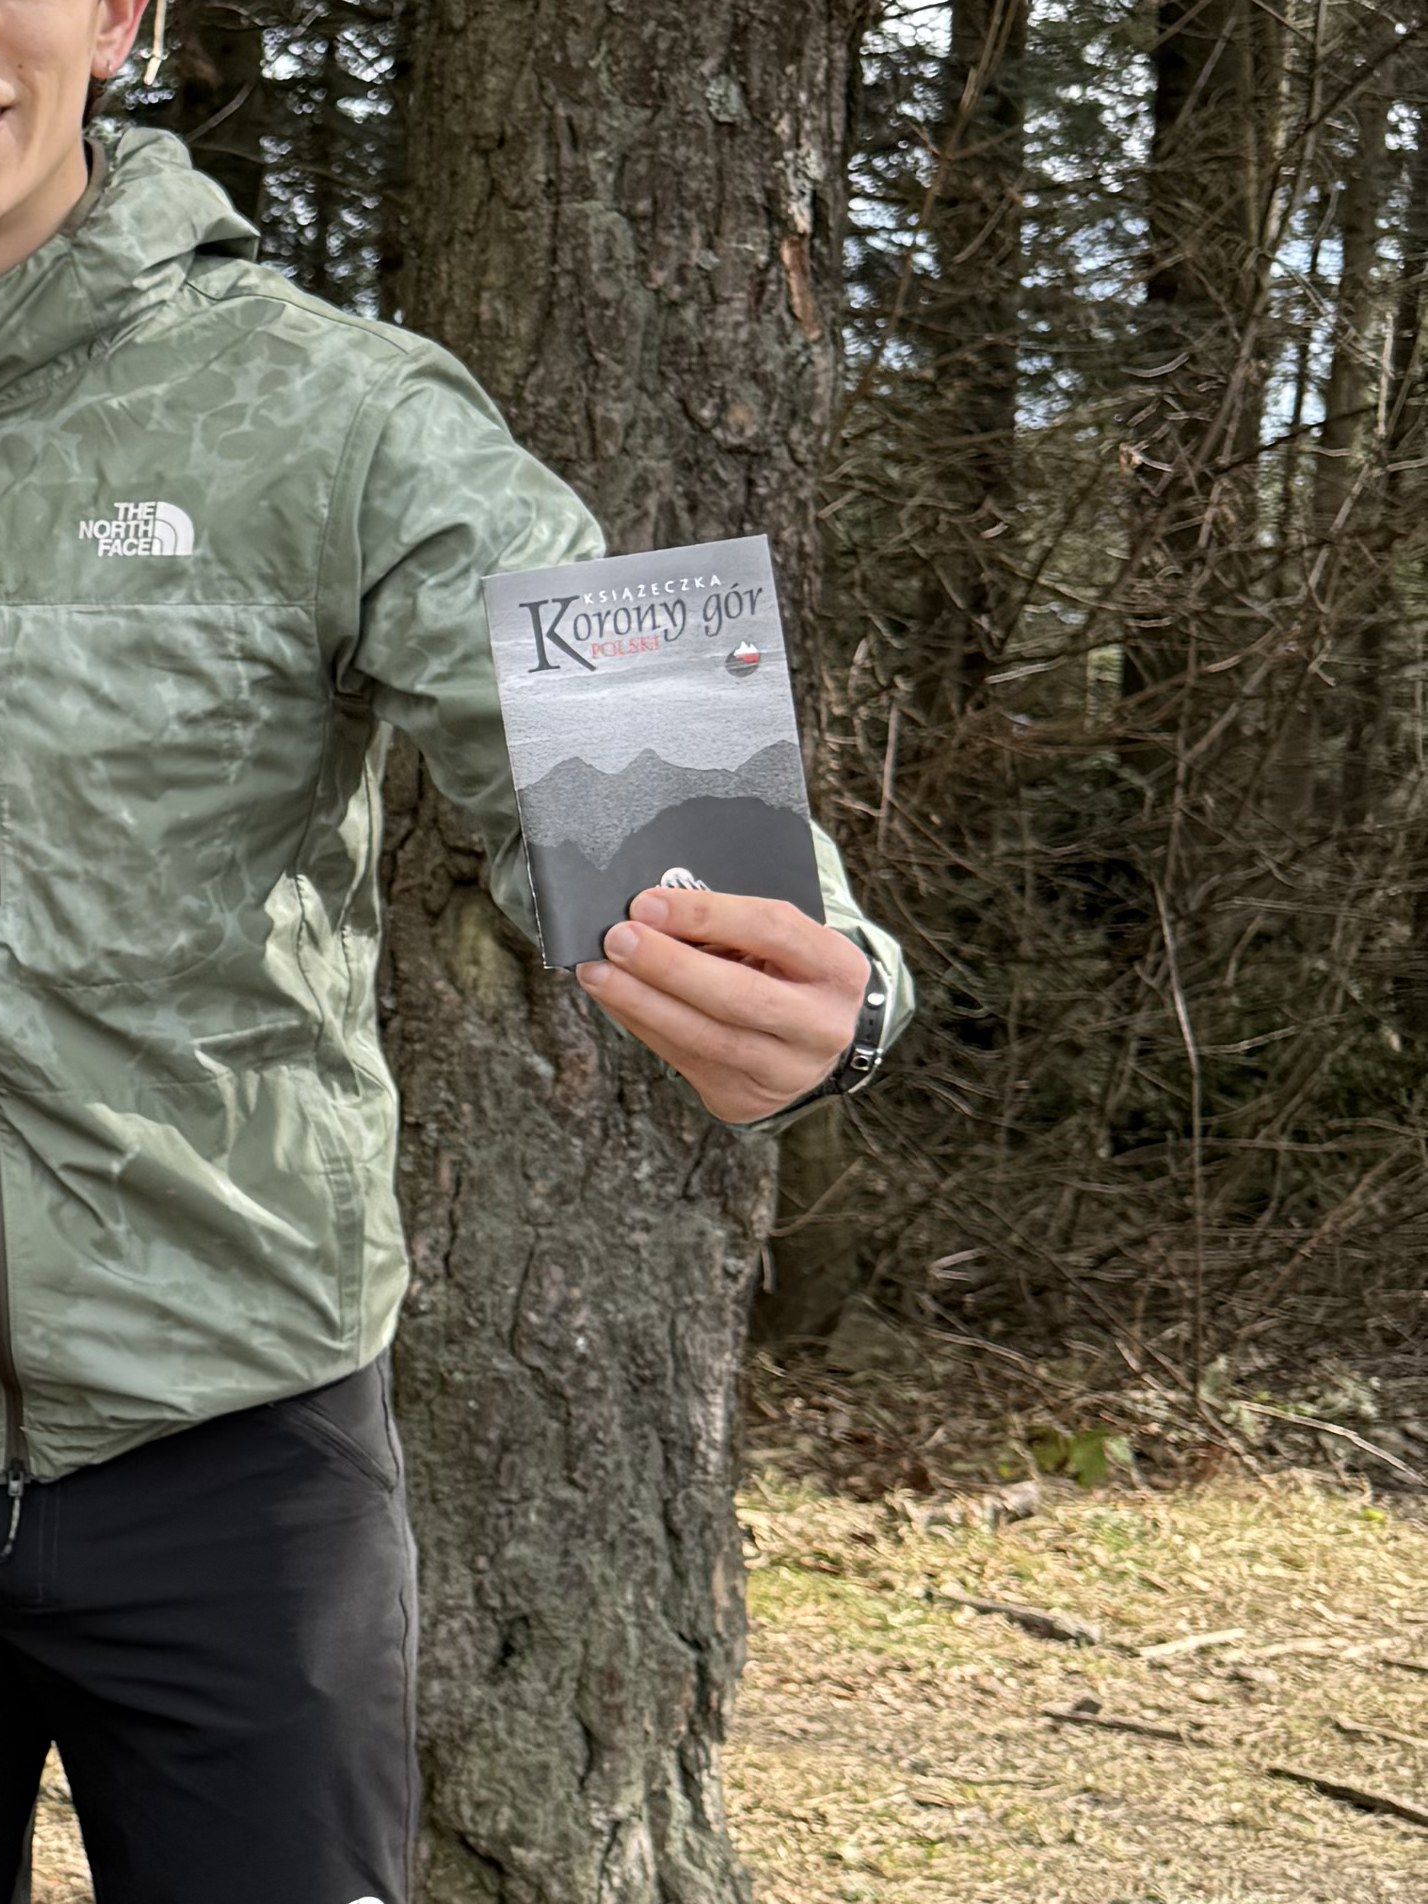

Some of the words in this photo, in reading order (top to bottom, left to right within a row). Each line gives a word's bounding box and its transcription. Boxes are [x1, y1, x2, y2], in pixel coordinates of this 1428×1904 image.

[113, 501, 156, 521] THE
[78, 518, 154, 540] NORTH
[97, 538, 153, 557] FACE
[518, 595, 687, 673] Korony
[702, 582, 763, 638] gór
[590, 634, 661, 660] POLSKI
